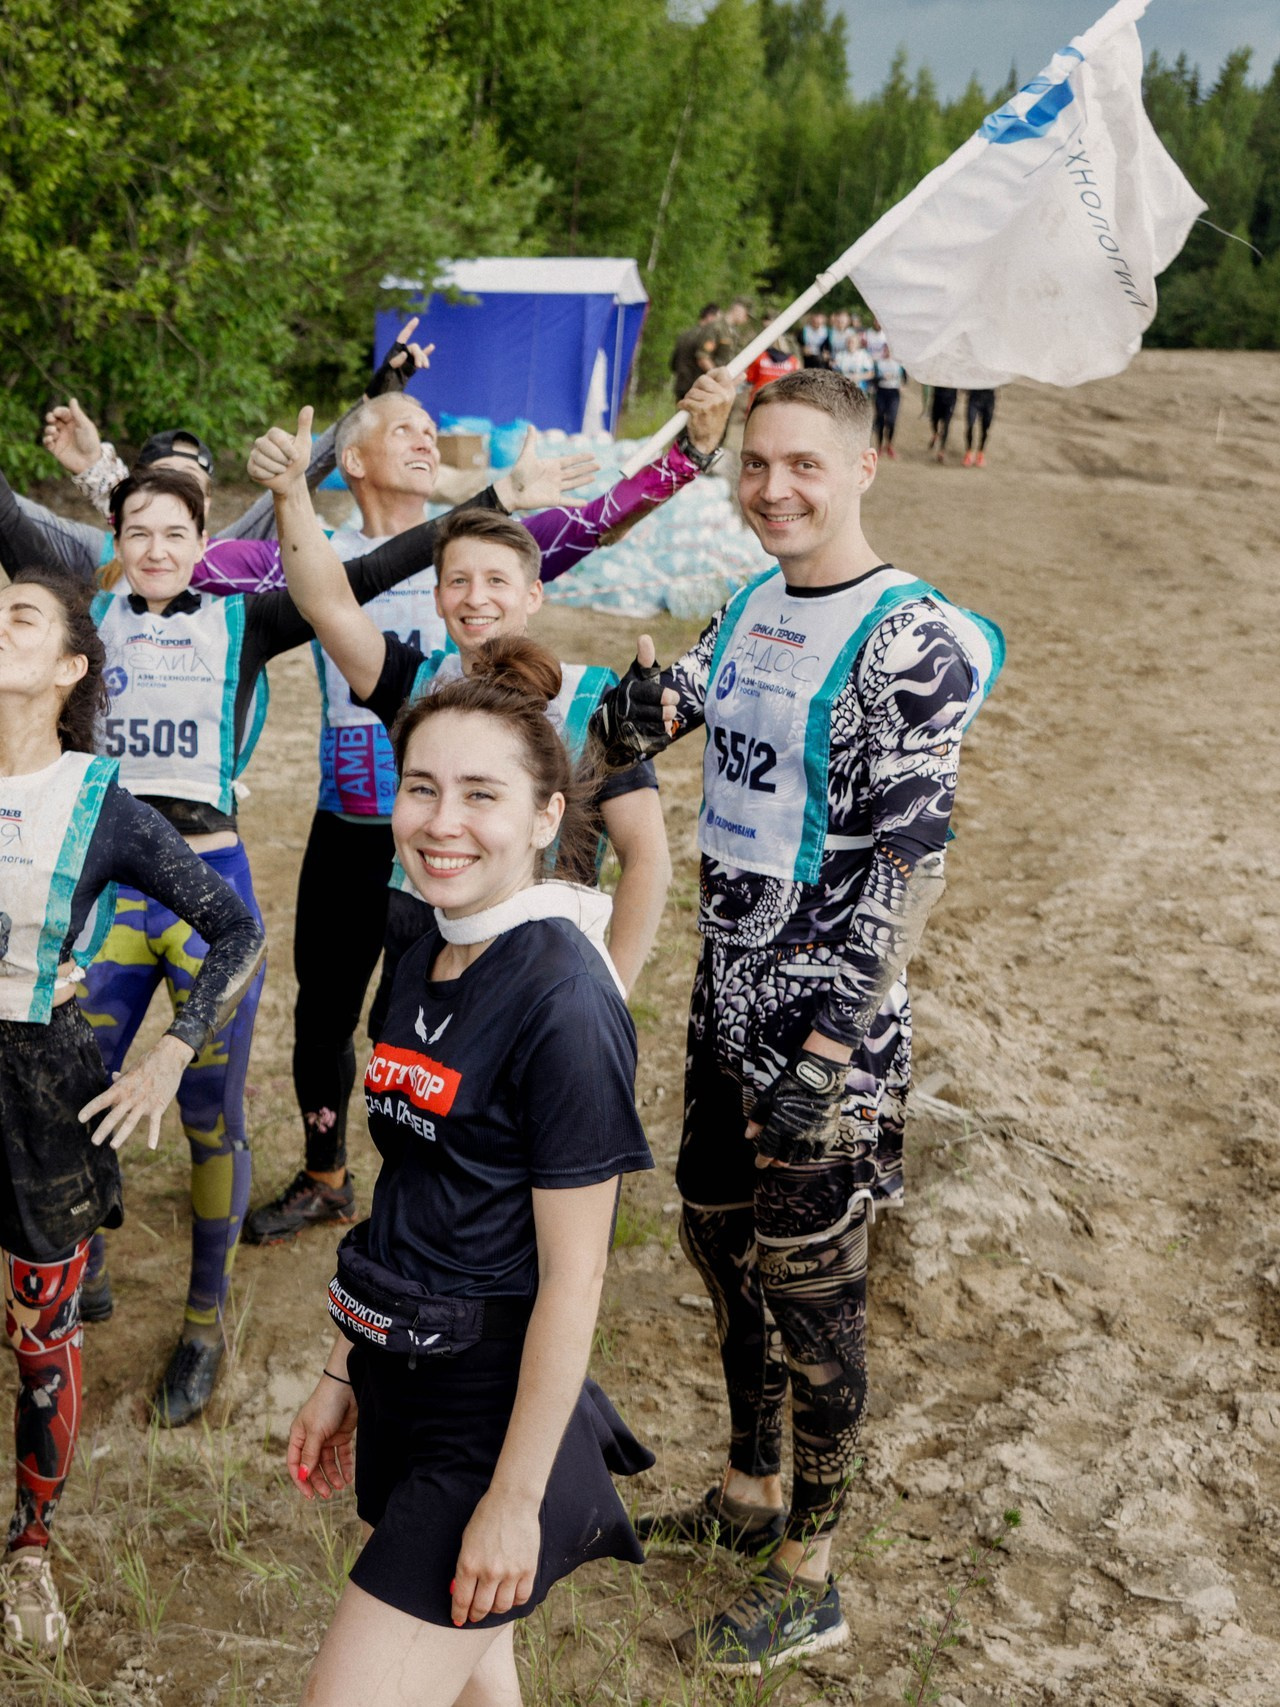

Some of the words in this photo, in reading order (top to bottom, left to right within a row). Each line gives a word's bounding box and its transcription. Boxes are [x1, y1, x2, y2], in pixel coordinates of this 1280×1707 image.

[1065, 138, 1149, 308] ХНОЛОГИИ
[105, 718, 199, 759] 5509
[328, 1276, 393, 1330] ИНСТРУКТОР
[347, 1317, 388, 1346] ГЕРОЕВ
